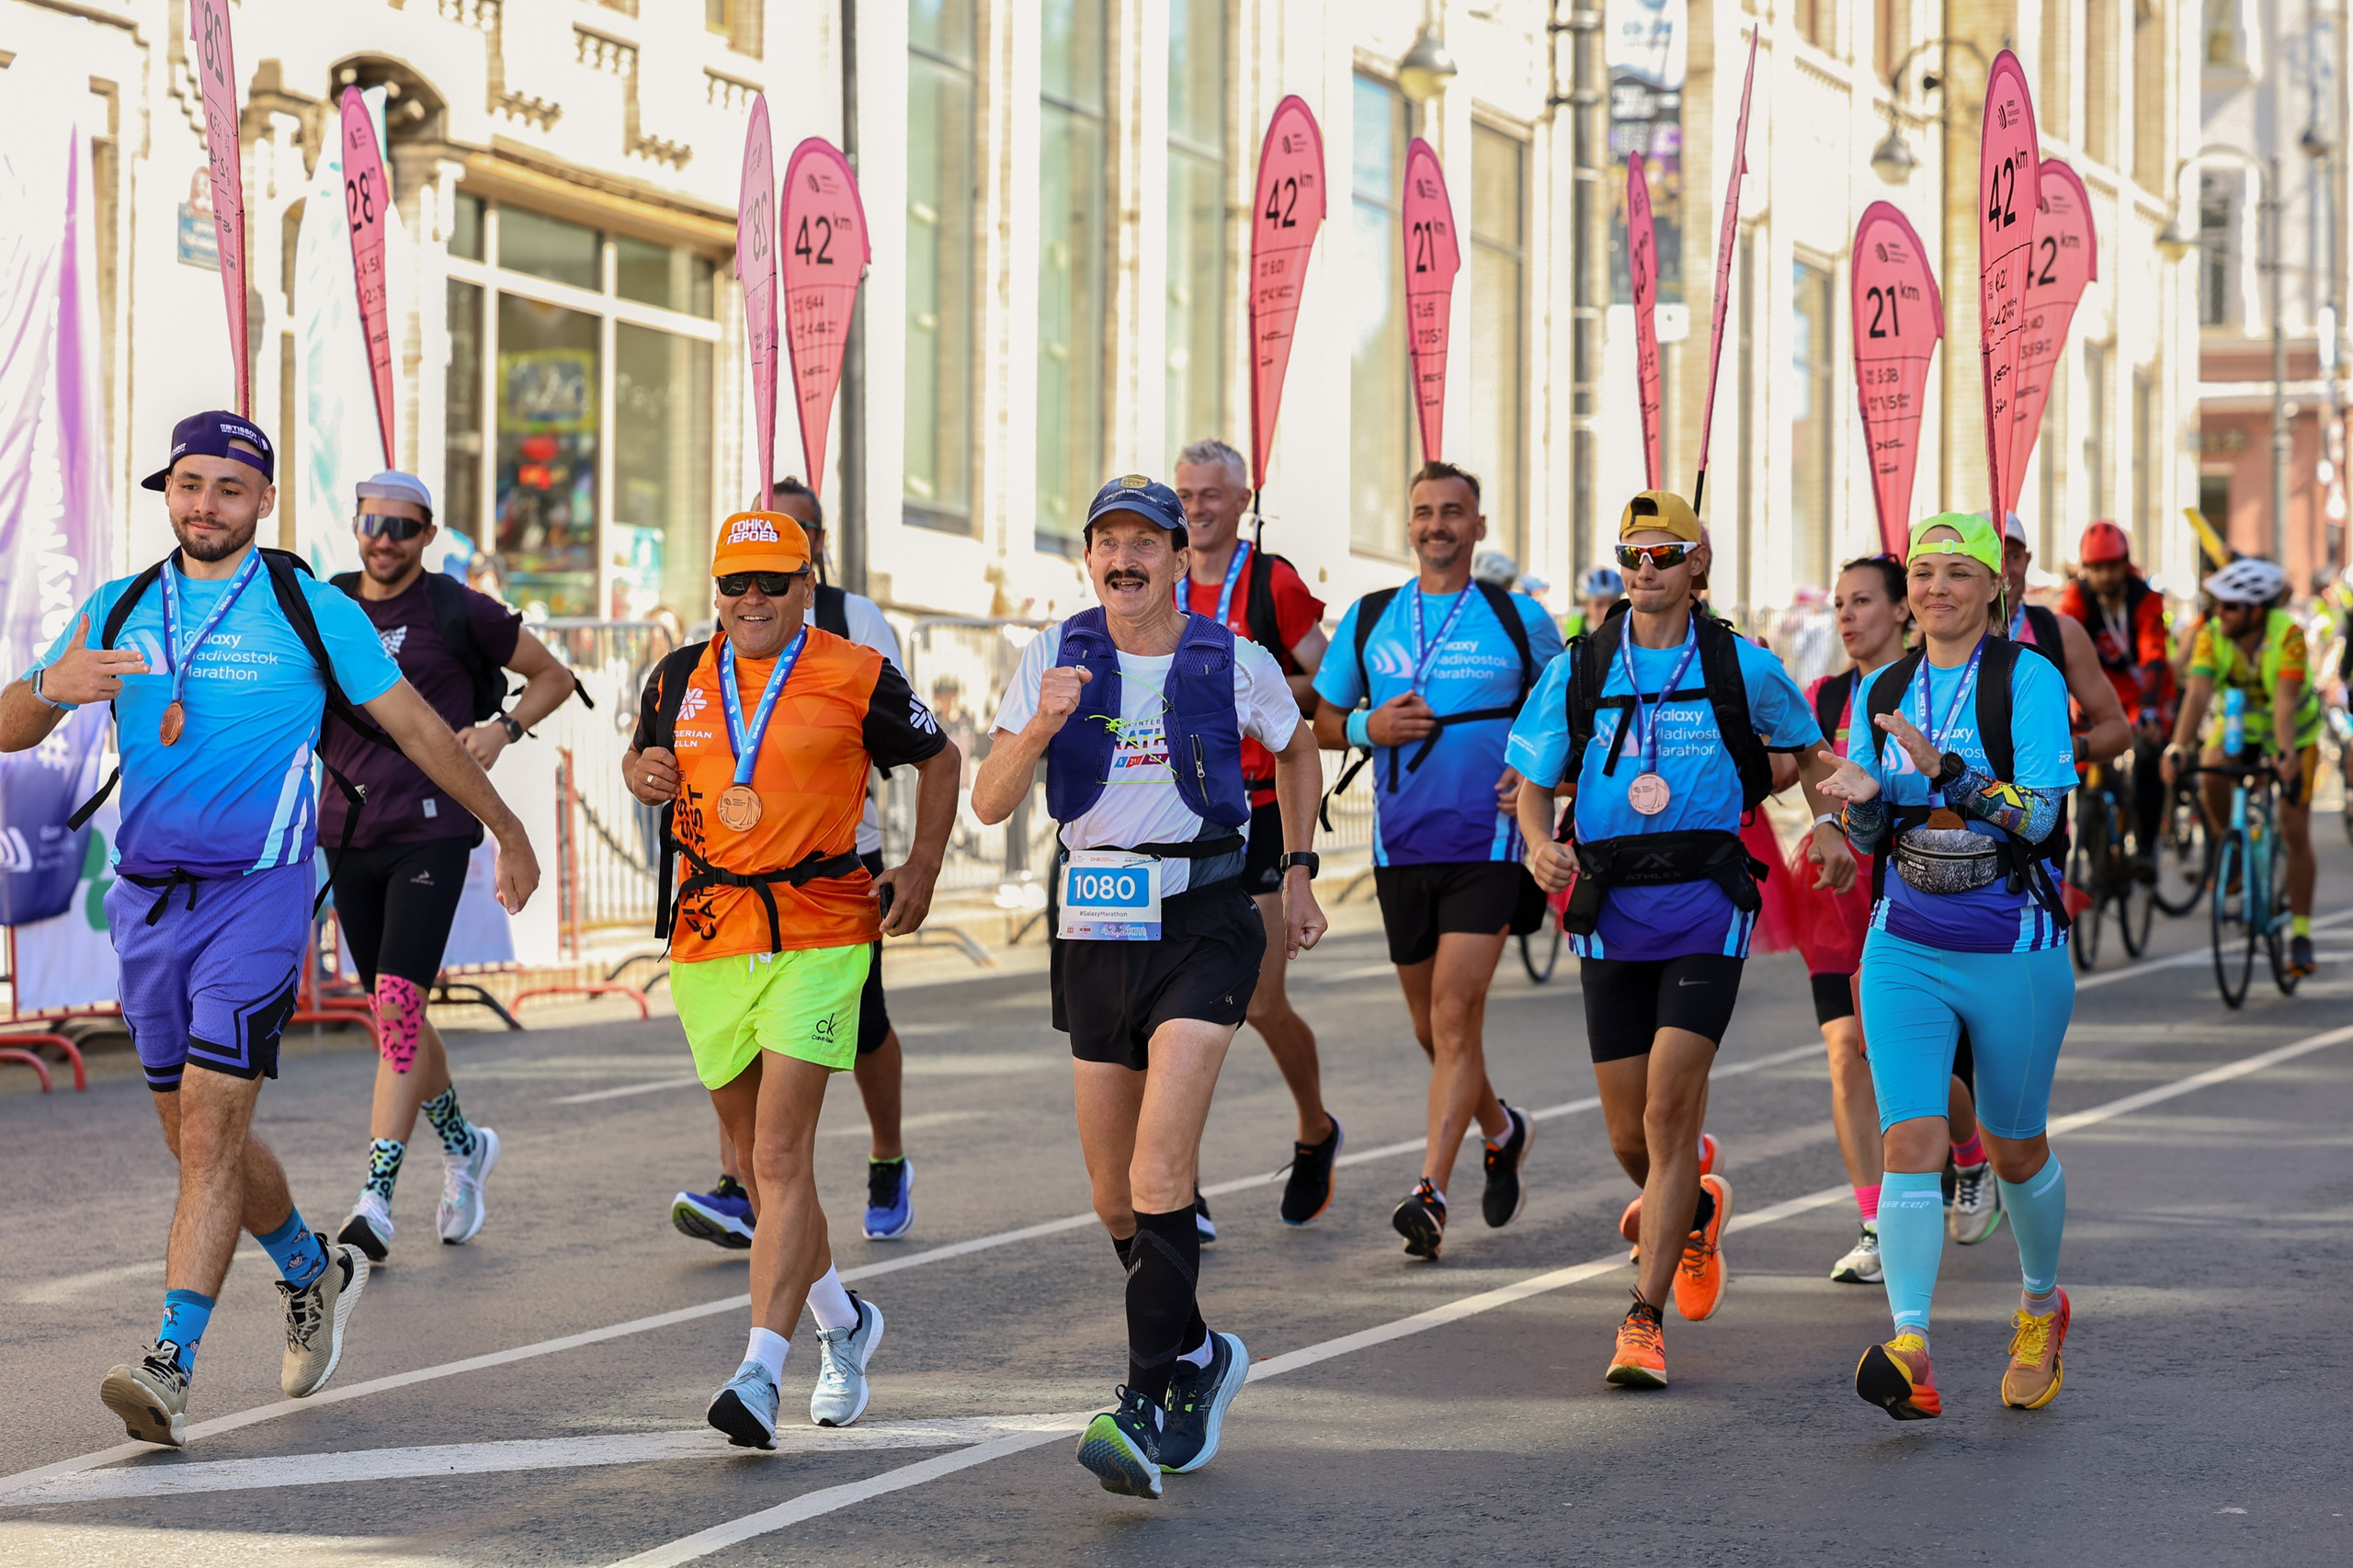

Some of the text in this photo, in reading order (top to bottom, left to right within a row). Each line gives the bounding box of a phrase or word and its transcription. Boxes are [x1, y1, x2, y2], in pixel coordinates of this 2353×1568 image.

[347, 172, 374, 233] 28
[1266, 178, 1297, 230] 42
[1989, 146, 2029, 233] 42 km
[795, 215, 834, 265] 42
[1414, 222, 1435, 272] 21
[2028, 231, 2080, 290] 2 km
[1867, 279, 1920, 338] 21 km
[726, 530, 779, 545] ГЕРОЕВ
[731, 518, 774, 534] ГОНКА
[774, 668, 786, 687] 28km
[1671, 664, 1682, 679] 10km
[1074, 875, 1136, 900] 1080
[1100, 925, 1146, 937] 42,2km
[1900, 1200, 1930, 1210] cep
